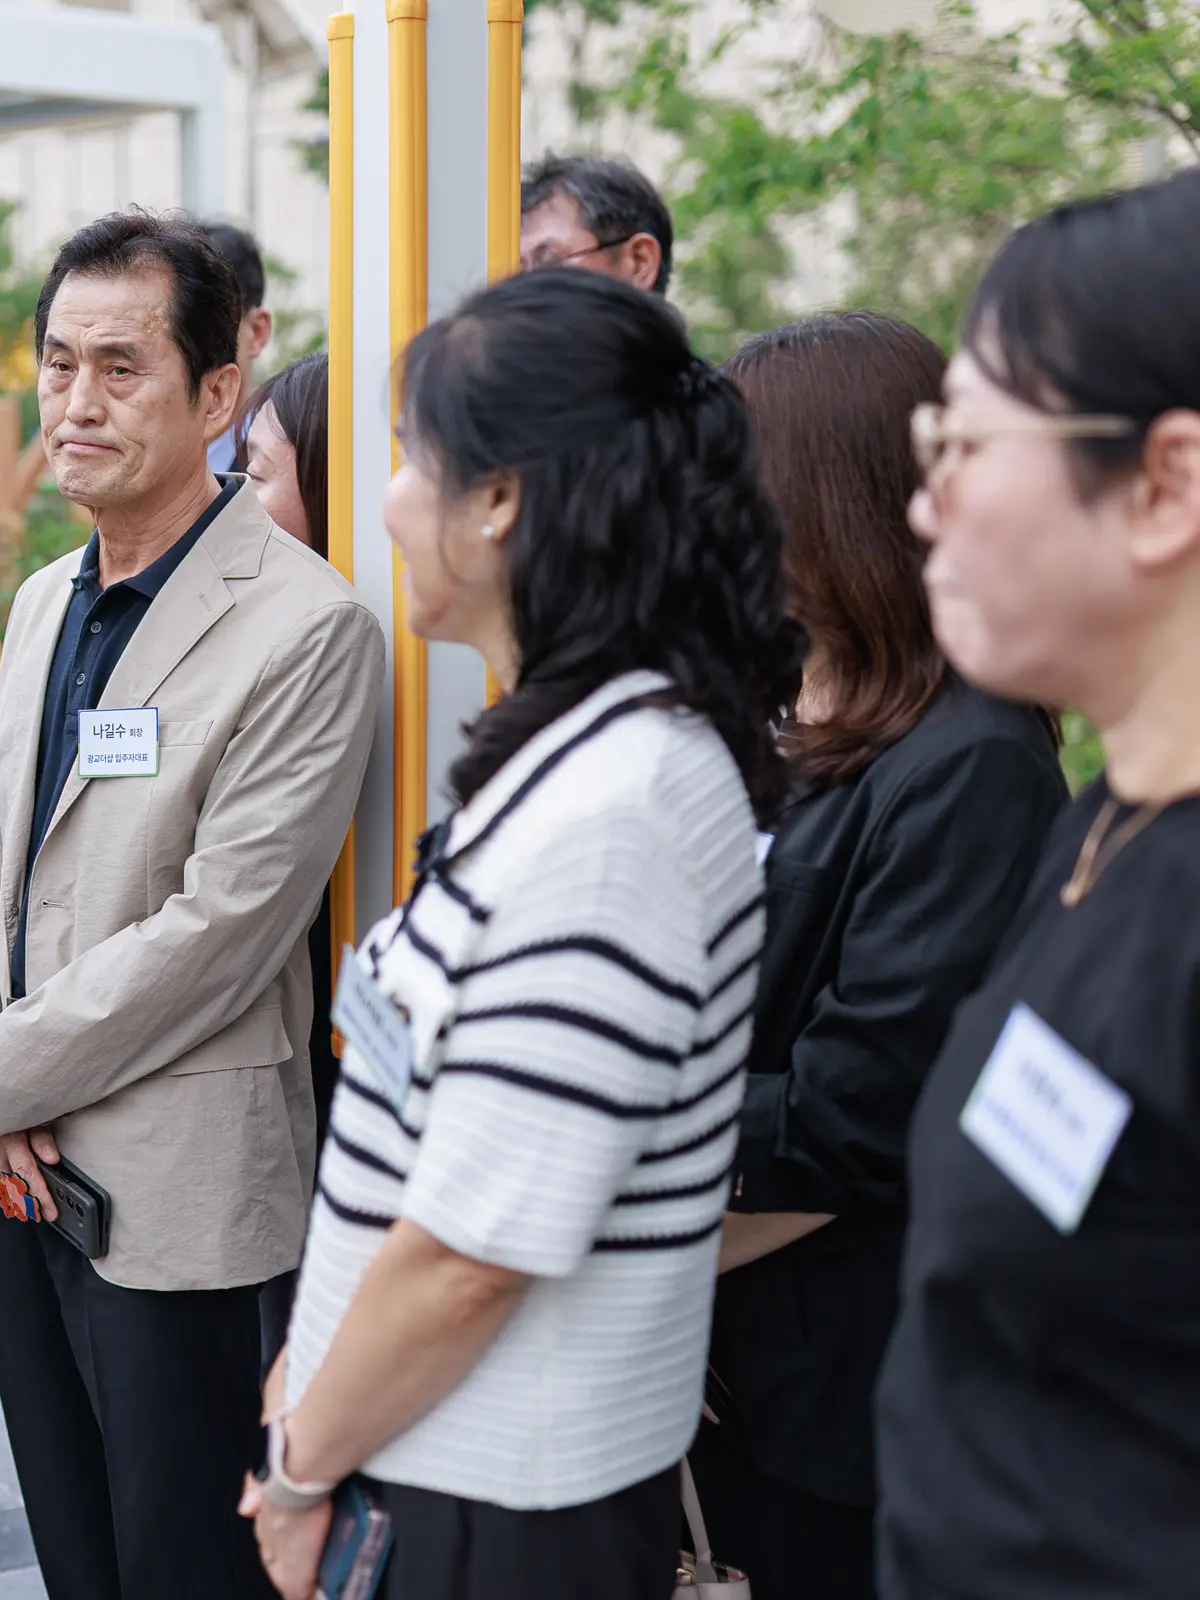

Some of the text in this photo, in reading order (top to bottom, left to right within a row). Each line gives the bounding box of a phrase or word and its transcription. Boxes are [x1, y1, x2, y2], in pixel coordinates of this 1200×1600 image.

[93, 723, 143, 739] 나길수 회장
[87, 753, 148, 764] 광교더샵 입주자대표
